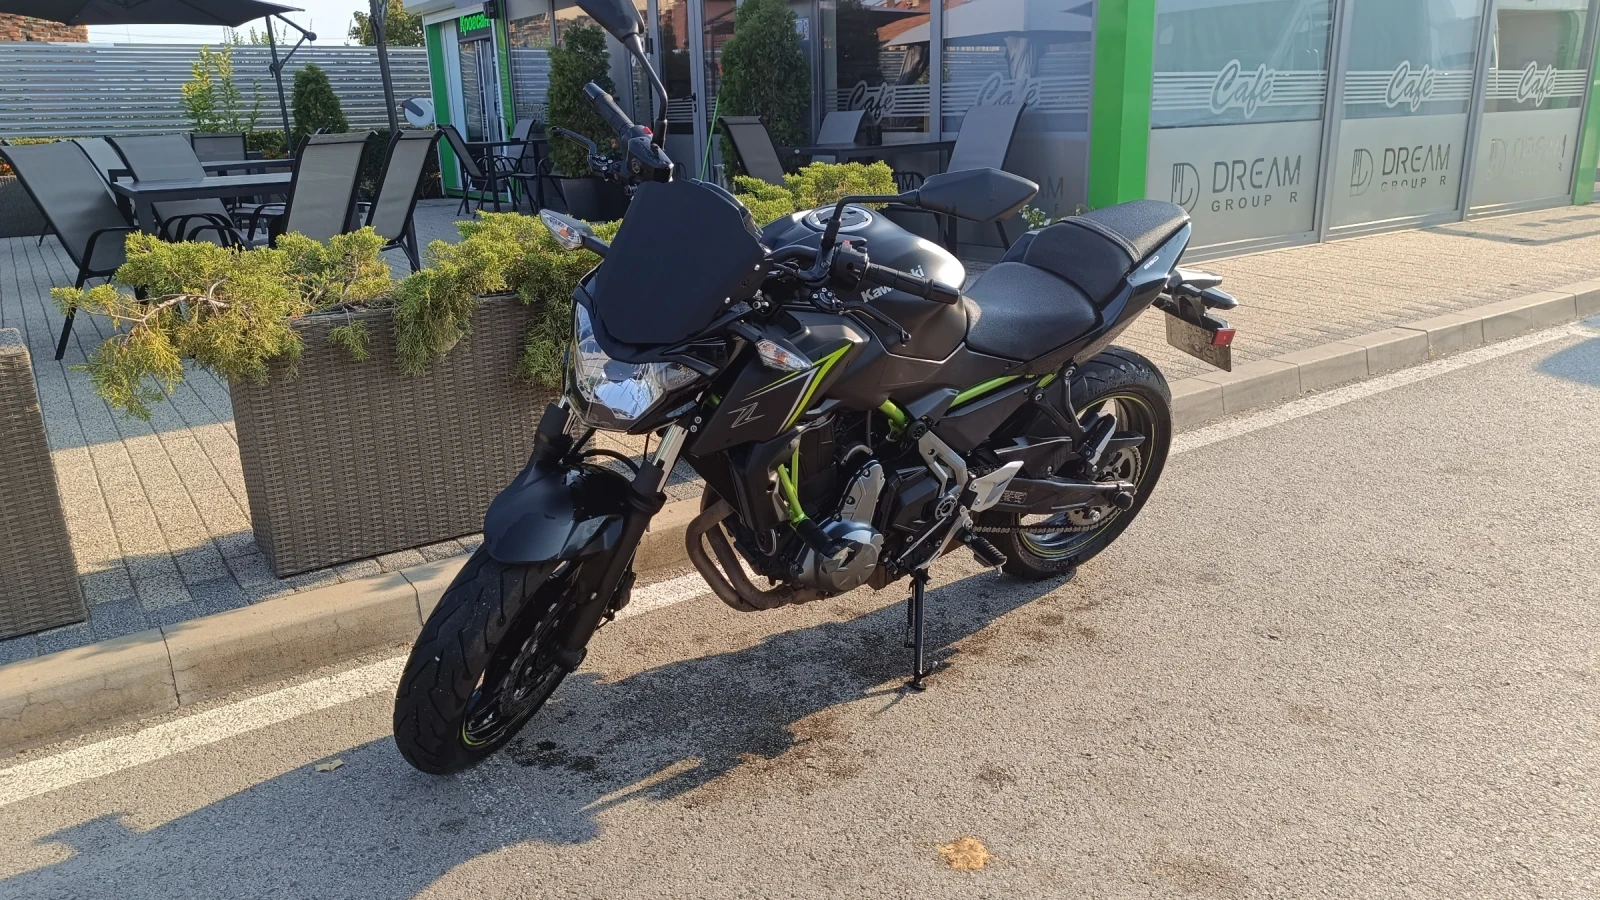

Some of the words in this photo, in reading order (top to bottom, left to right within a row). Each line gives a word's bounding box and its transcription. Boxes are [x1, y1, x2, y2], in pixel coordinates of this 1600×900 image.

[848, 83, 894, 120] Café
[1211, 62, 1274, 116] Café
[1386, 63, 1435, 110] Café
[1517, 63, 1556, 105] Café
[1212, 155, 1302, 193] DREAM
[1382, 143, 1450, 176] DREAM
[1211, 194, 1272, 212] GROUP
[1289, 191, 1298, 203] R
[1381, 177, 1427, 192] GROUP
[1440, 175, 1446, 186] R
[860, 264, 925, 303] Kawki
